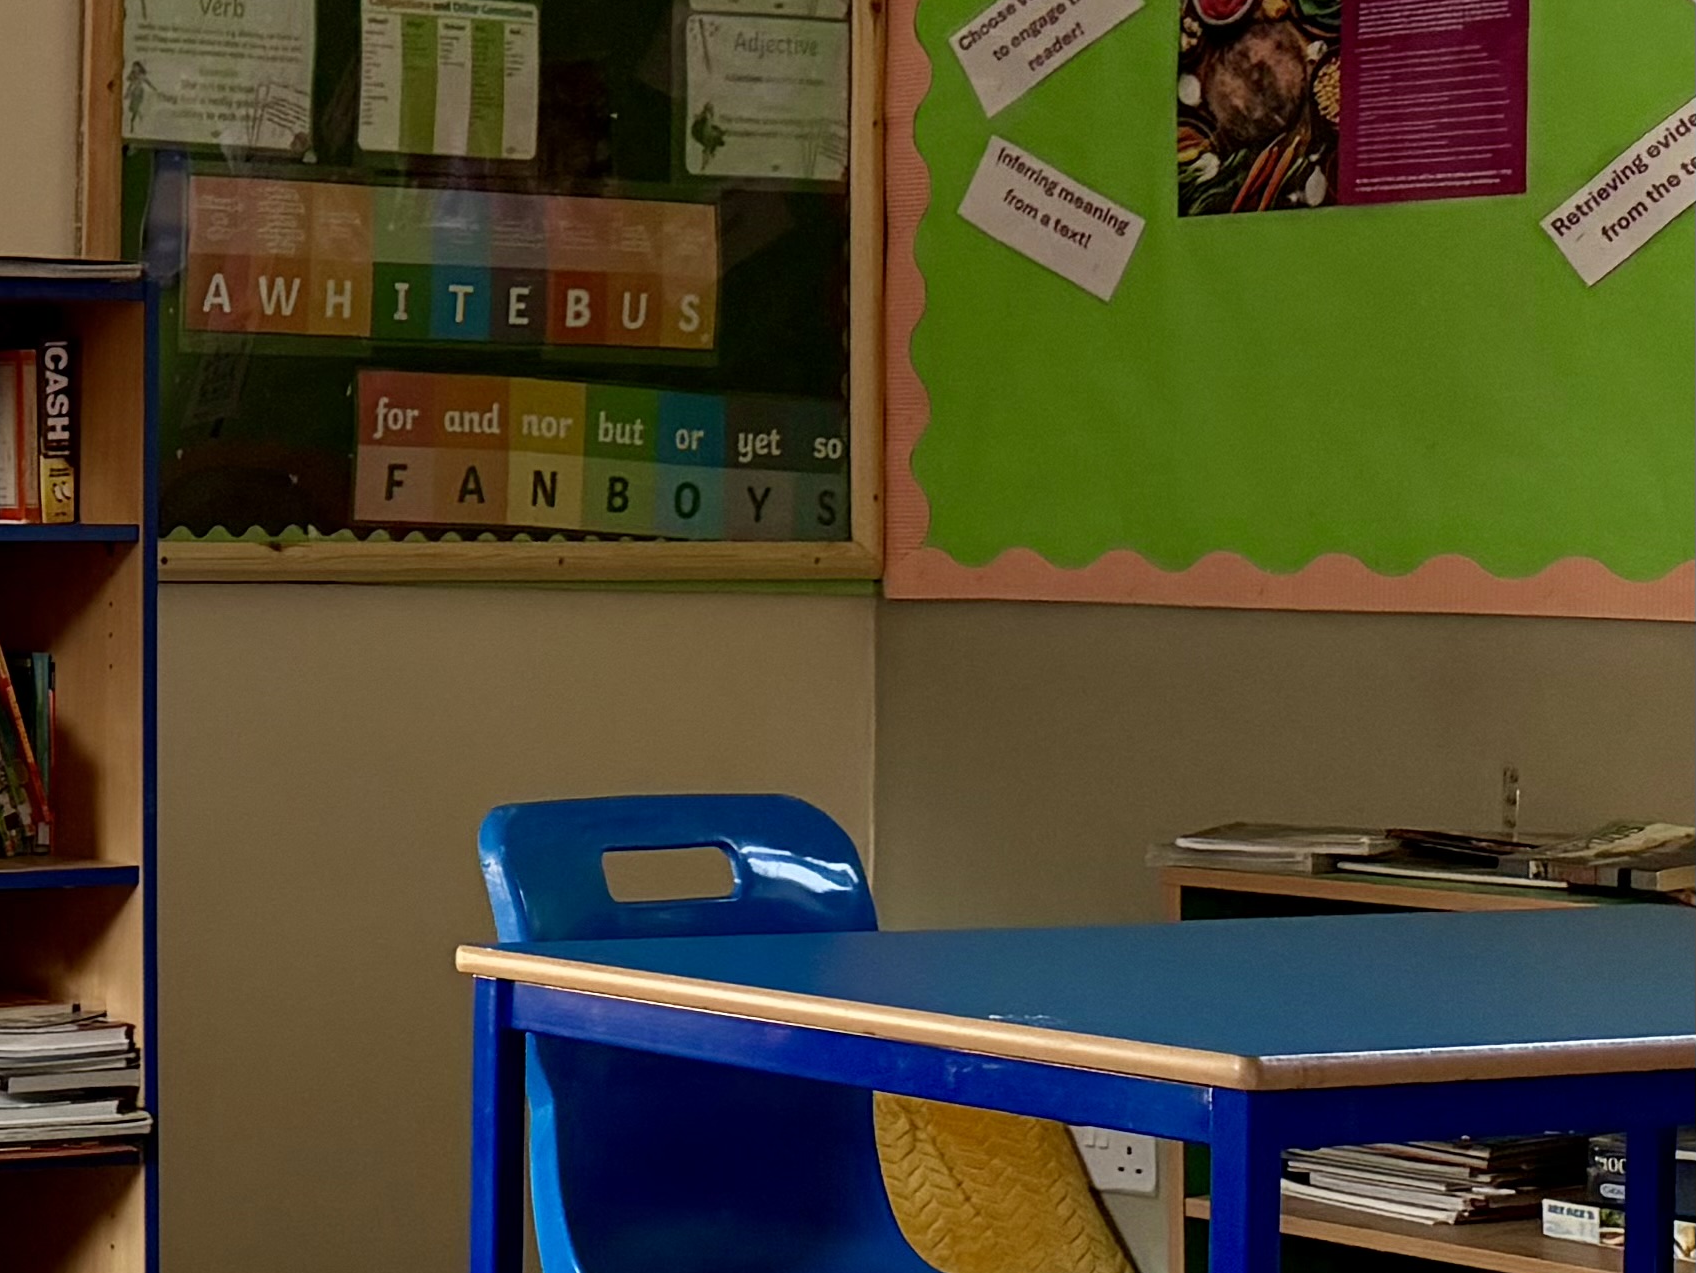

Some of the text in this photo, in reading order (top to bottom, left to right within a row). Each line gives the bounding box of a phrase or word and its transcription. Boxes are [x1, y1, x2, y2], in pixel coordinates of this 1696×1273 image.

[734, 32, 817, 59] Adjective
[959, 4, 1016, 51] Choose
[993, 45, 1010, 61] to
[1011, 3, 1067, 48] engage
[1028, 22, 1084, 71] reader!
[996, 147, 1130, 237] Inferring meaning
[1004, 188, 1092, 249] from a text!
[1551, 154, 1649, 237] Retrieving
[1602, 174, 1681, 242] from the
[44, 347, 71, 448] CASH
[373, 397, 843, 463] for and nor but or yet so
